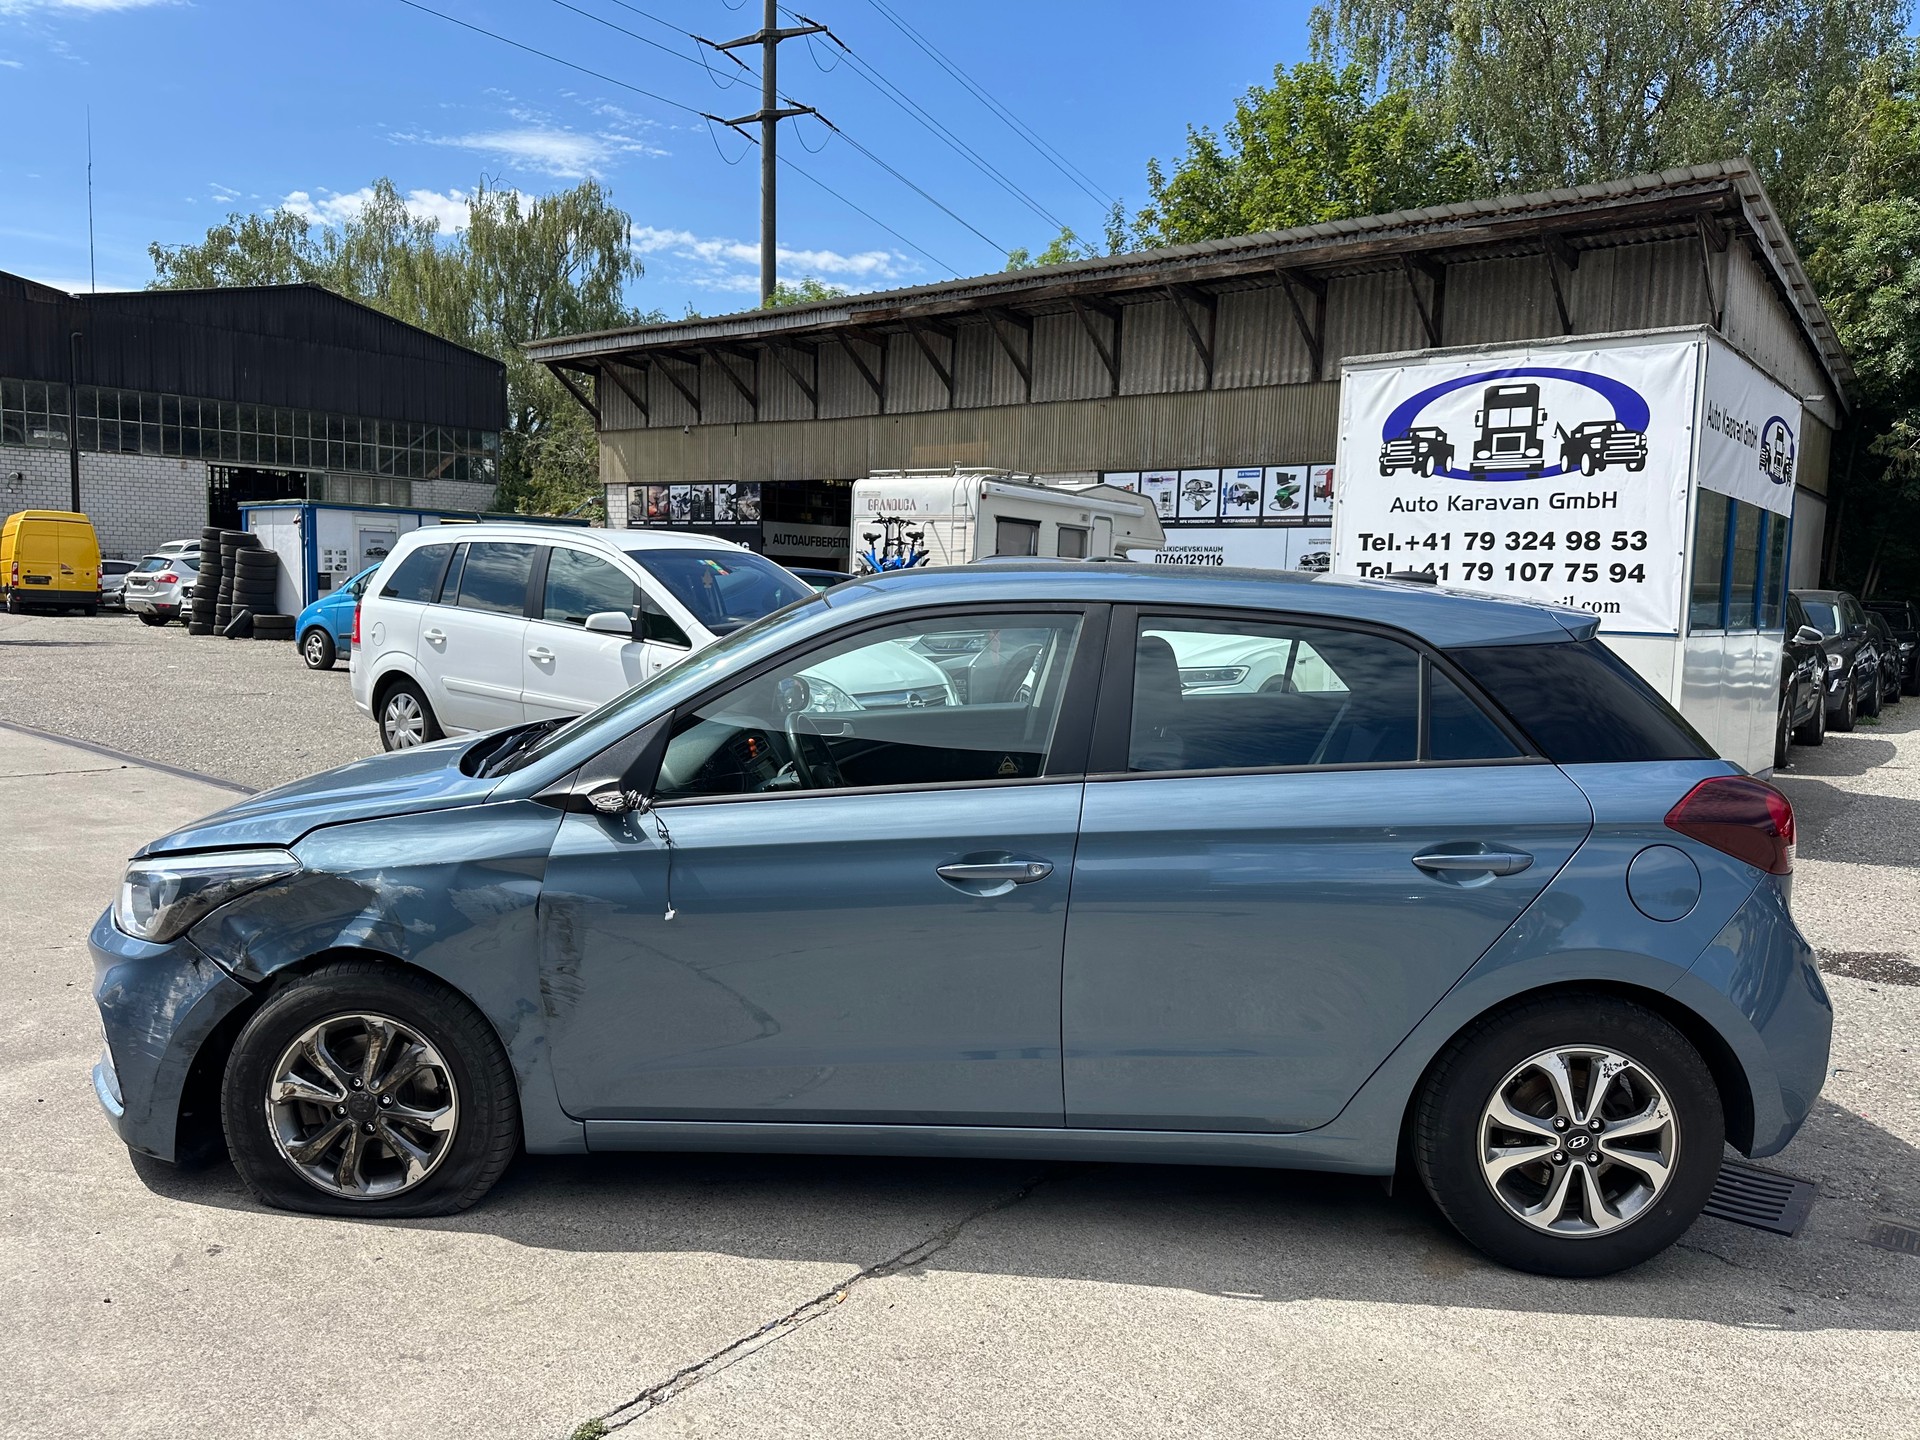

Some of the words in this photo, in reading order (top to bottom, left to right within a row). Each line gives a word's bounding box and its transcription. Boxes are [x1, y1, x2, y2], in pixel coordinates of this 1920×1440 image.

[1706, 399, 1721, 432] Auto
[1721, 407, 1744, 443] Karavan
[1743, 420, 1759, 451] GmbH
[867, 498, 917, 511] GRANDUCA
[1389, 496, 1439, 513] Auto
[1447, 495, 1539, 512] Karavan
[1548, 491, 1618, 510] GmbH
[1358, 532, 1451, 552] Tel.+41
[1463, 532, 1496, 551] 79
[1504, 531, 1556, 551] 324
[1565, 531, 1601, 551] 98
[1611, 530, 1648, 551] 53
[1461, 562, 1494, 582] 79
[1504, 562, 1554, 582] 107
[1564, 563, 1599, 583] 75
[1608, 563, 1646, 583] 94
